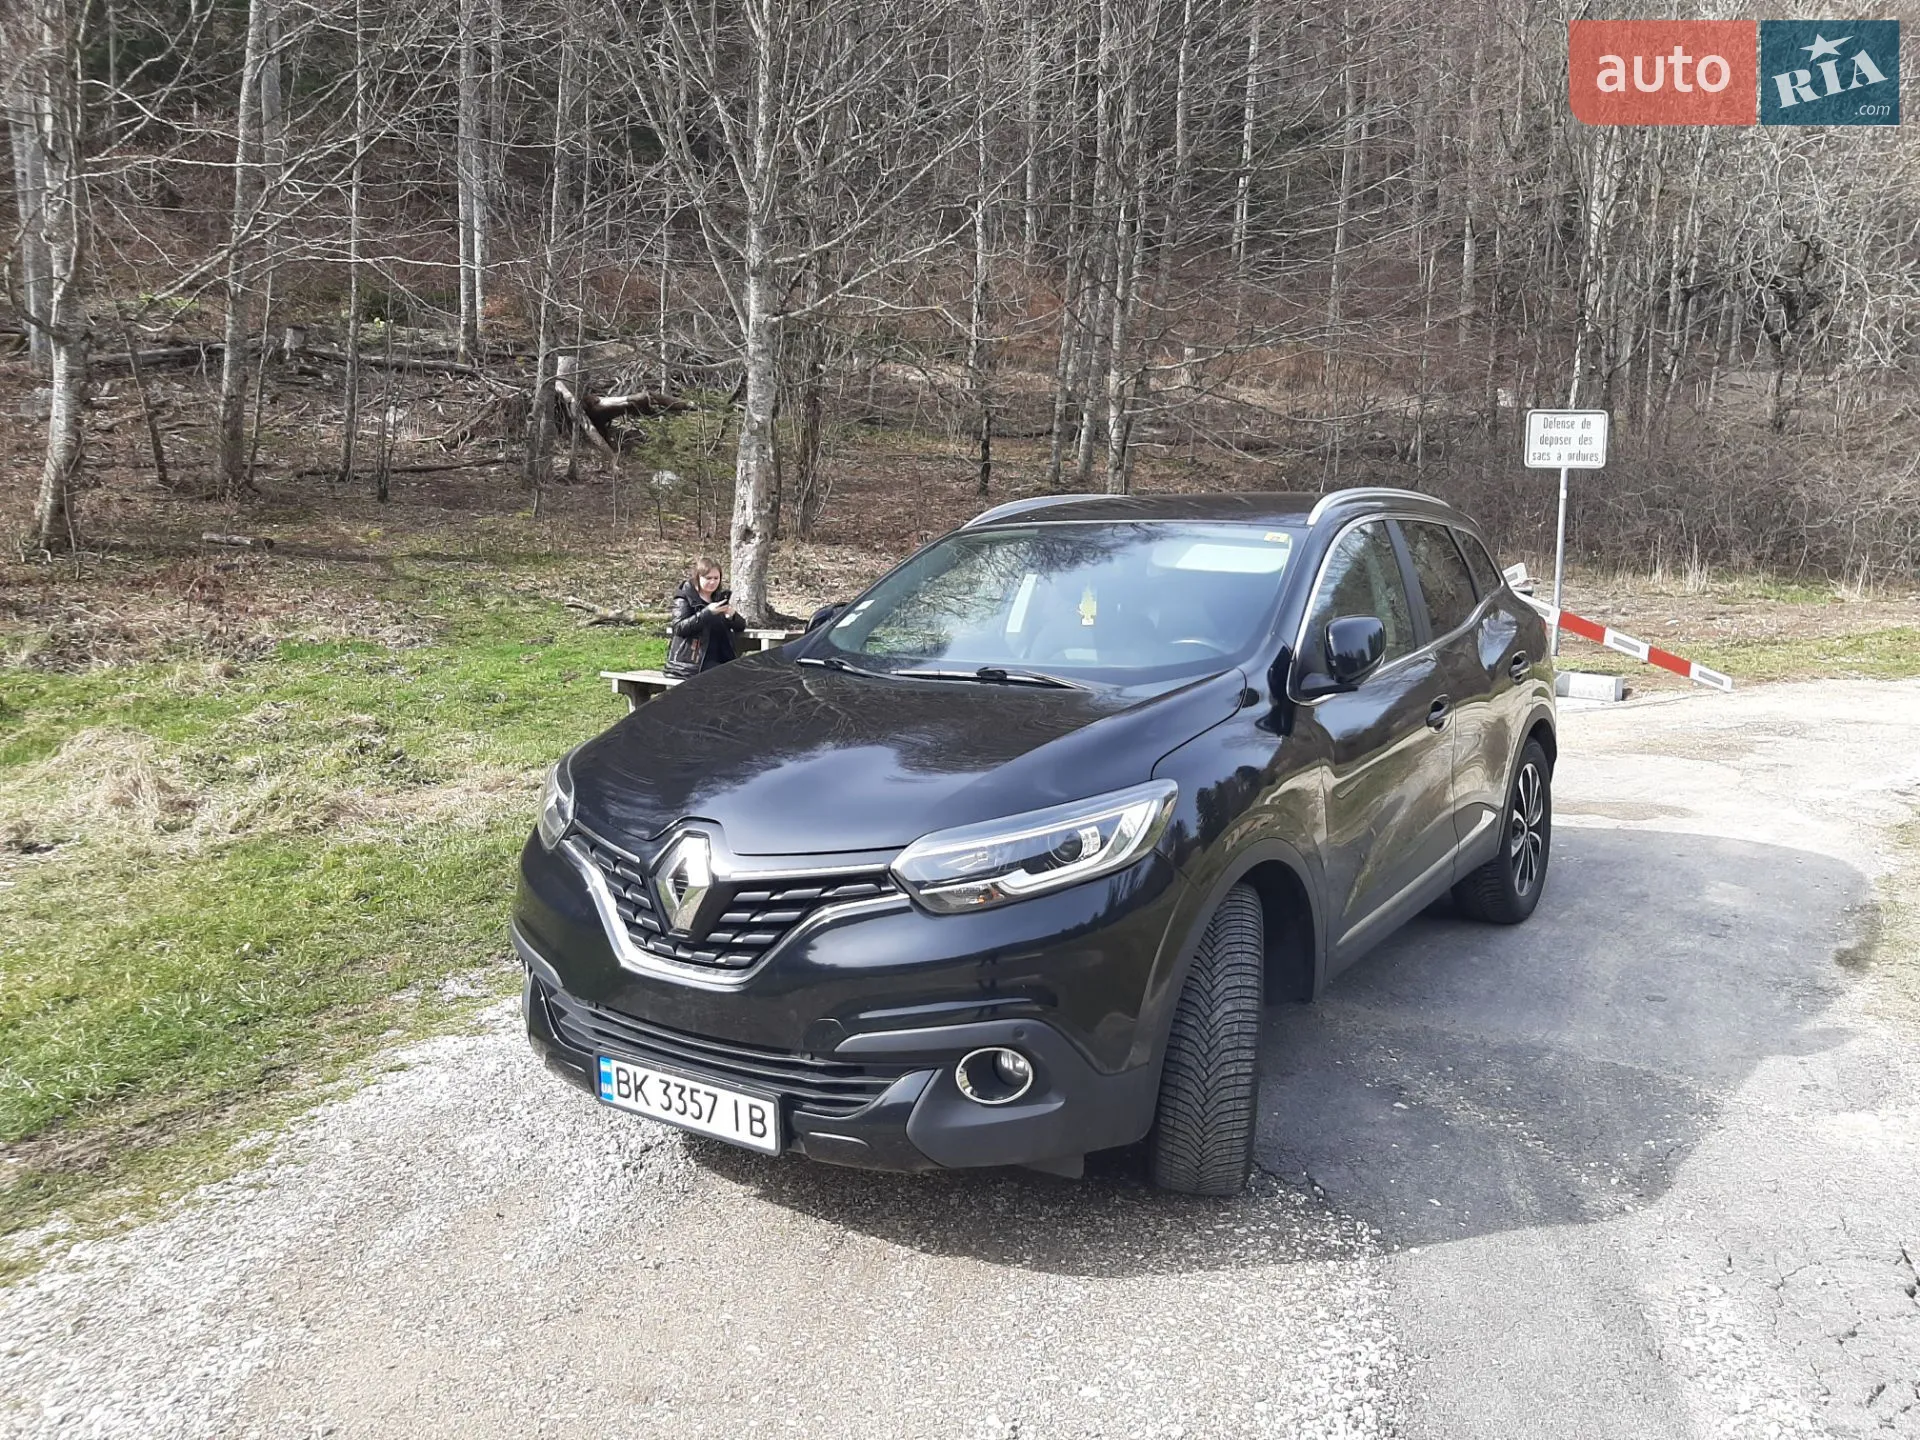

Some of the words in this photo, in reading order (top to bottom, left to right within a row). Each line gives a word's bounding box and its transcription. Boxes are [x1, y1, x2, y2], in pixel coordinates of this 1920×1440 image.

[1581, 417, 1592, 430] de
[1578, 433, 1593, 446] des
[1532, 451, 1551, 462] sacs
[1567, 450, 1599, 462] ordures
[601, 1083, 612, 1094] UA
[616, 1066, 651, 1106] BK
[658, 1078, 718, 1124] 3357
[734, 1098, 767, 1138] IB
